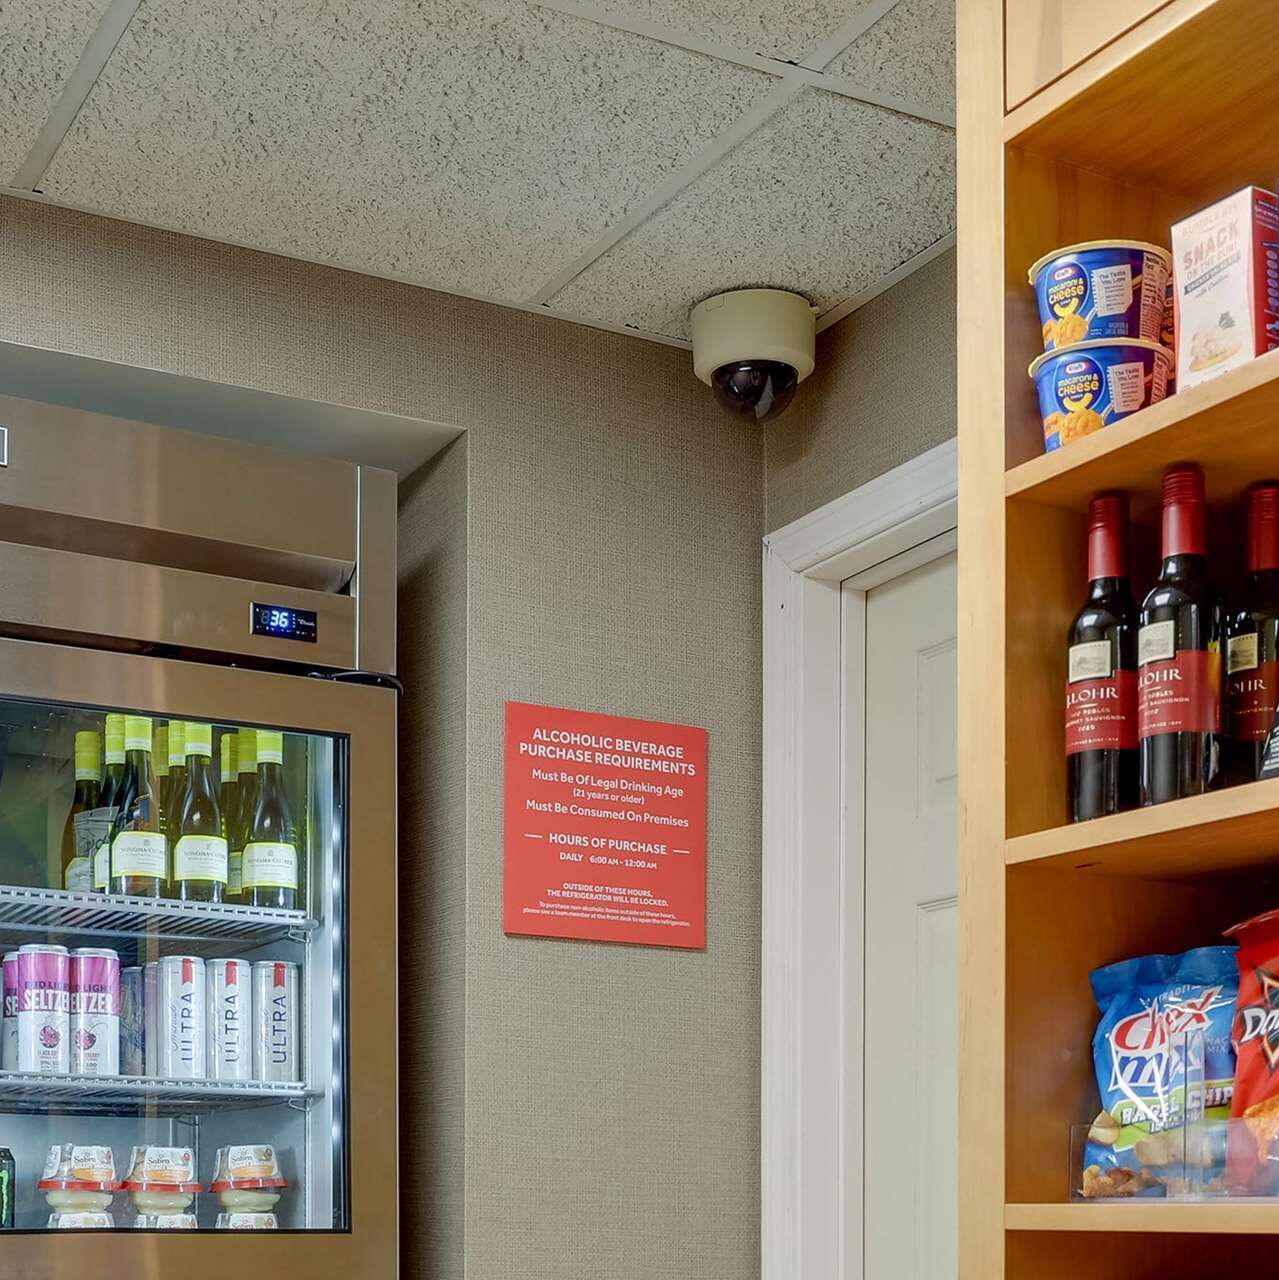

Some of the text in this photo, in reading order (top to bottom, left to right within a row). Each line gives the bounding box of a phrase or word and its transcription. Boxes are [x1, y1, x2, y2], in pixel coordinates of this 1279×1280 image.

[1184, 221, 1240, 271] SNACK
[270, 610, 289, 628] 36
[533, 728, 684, 759] ALCOHOLIC BEVERAGE
[520, 742, 696, 776] PURCHASE REQUIREMENTS
[532, 769, 684, 799] Must Be Of Legal Drinking Age
[573, 788, 645, 806] (21 years or older)
[526, 799, 689, 828] Must Be Consumed On Premises
[549, 832, 667, 856] HOURS OF PURCHASE
[559, 851, 646, 870] DAILY 6:00 12:00
[547, 889, 639, 905] THE REFRIGERATOR BE
[563, 882, 593, 893] OUTSIDE
[606, 886, 627, 896] THESE
[180, 992, 193, 1062] ULTRA
[225, 993, 239, 1062] ULTRA
[272, 995, 287, 1064] ULTRA
[1113, 986, 1224, 1052] Chex
